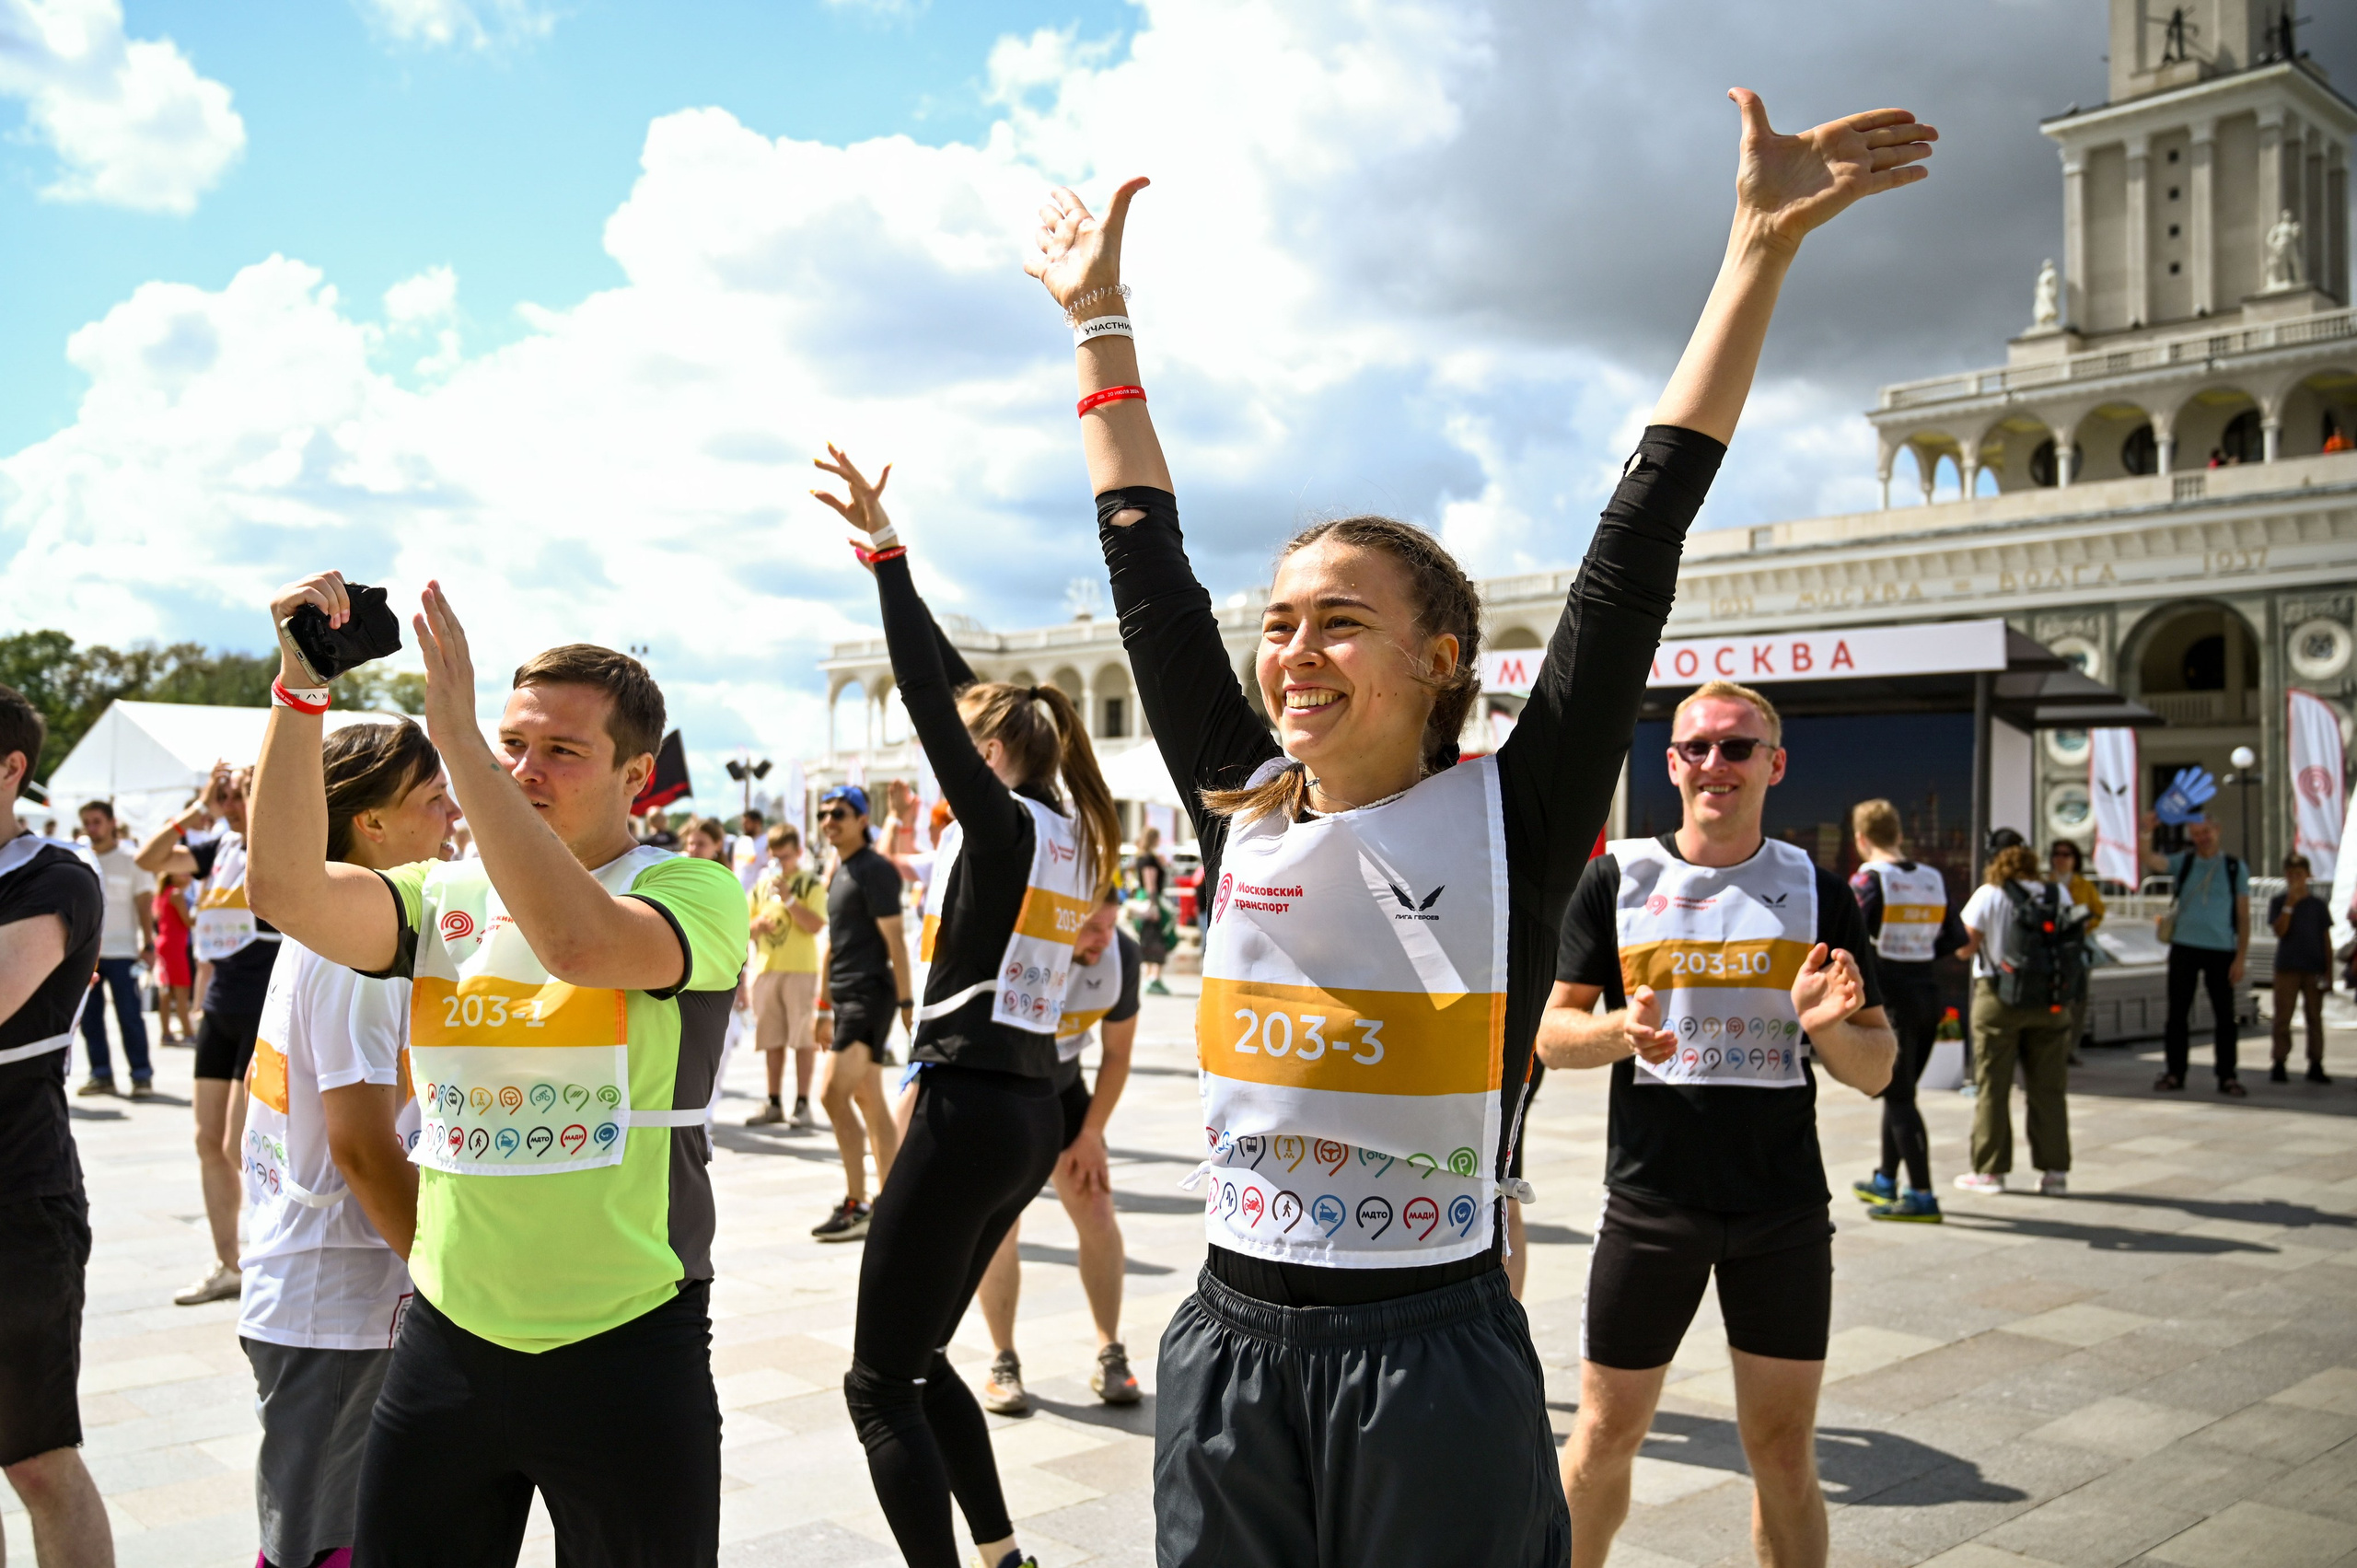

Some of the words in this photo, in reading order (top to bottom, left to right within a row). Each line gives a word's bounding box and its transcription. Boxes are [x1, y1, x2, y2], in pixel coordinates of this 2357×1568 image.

[1236, 881, 1304, 898] Московский
[1234, 899, 1290, 914] транспорт
[1669, 950, 1771, 975] 203-10
[442, 994, 546, 1028] 203-1
[1235, 1007, 1385, 1065] 203-3
[530, 1135, 551, 1144] МДТО
[1361, 1210, 1388, 1220] МДТО
[1408, 1210, 1434, 1221] МАДИ
